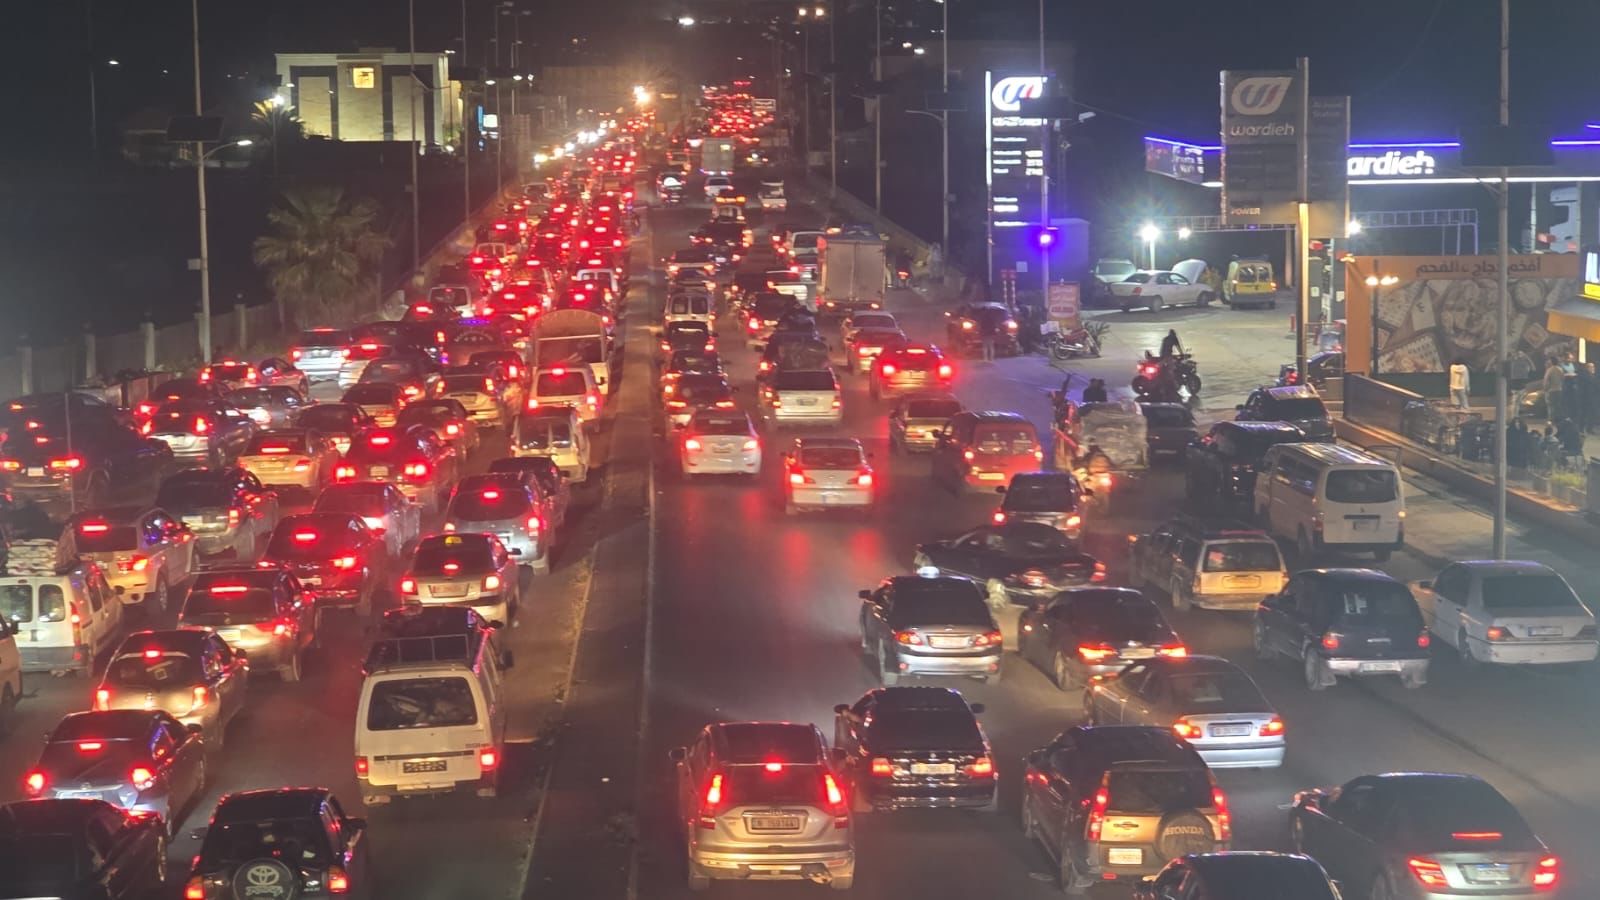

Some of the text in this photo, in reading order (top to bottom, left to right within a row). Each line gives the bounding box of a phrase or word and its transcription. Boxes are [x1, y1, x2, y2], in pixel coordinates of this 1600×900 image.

[1231, 122, 1295, 136] wardieh
[1347, 150, 1435, 176] ardieh
[1164, 825, 1205, 836] HONDA
